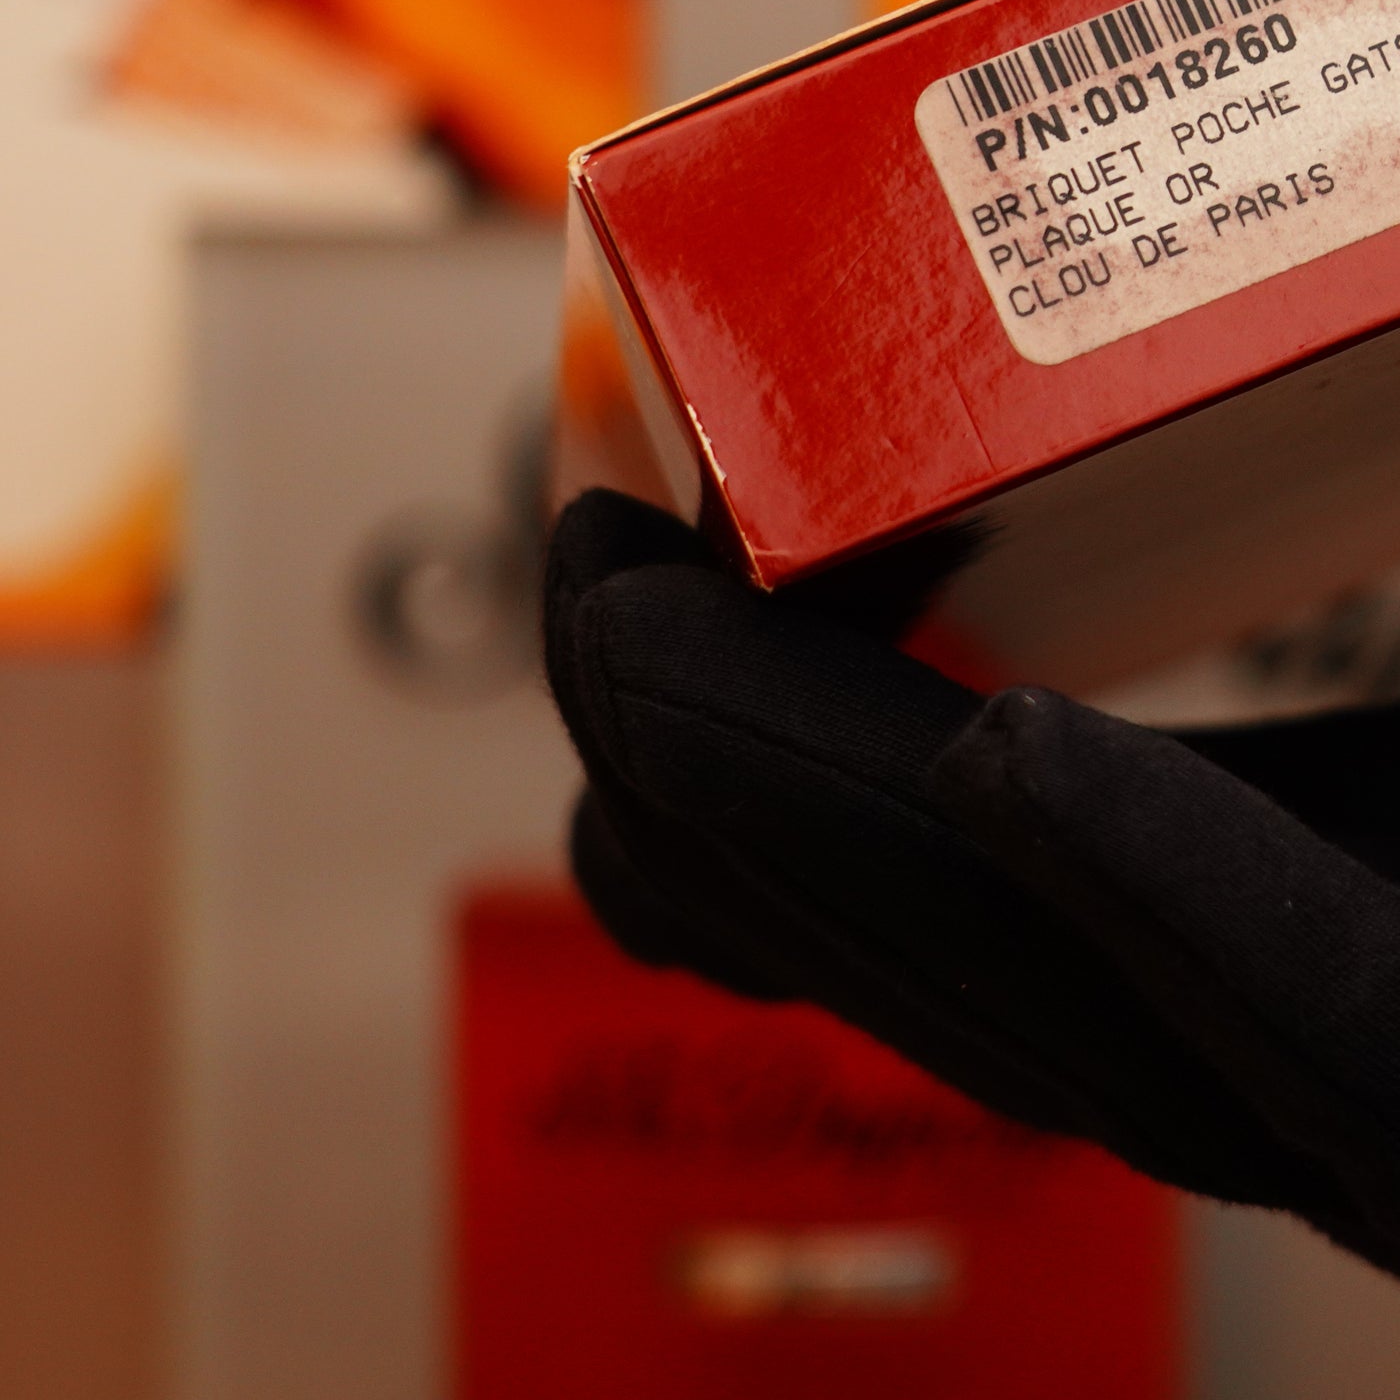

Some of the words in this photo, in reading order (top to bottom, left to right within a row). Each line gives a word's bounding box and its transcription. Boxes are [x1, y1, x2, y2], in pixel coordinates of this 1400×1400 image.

[972, 141, 1144, 237] BRIQUET
[1170, 80, 1301, 155] POCHE
[975, 13, 1297, 172] P/N:0018260
[989, 192, 1145, 273] PLAQUE
[1165, 162, 1220, 205] OR
[1008, 252, 1112, 318] CLOU
[1131, 222, 1189, 269] DE
[1206, 163, 1335, 237] PARIS
